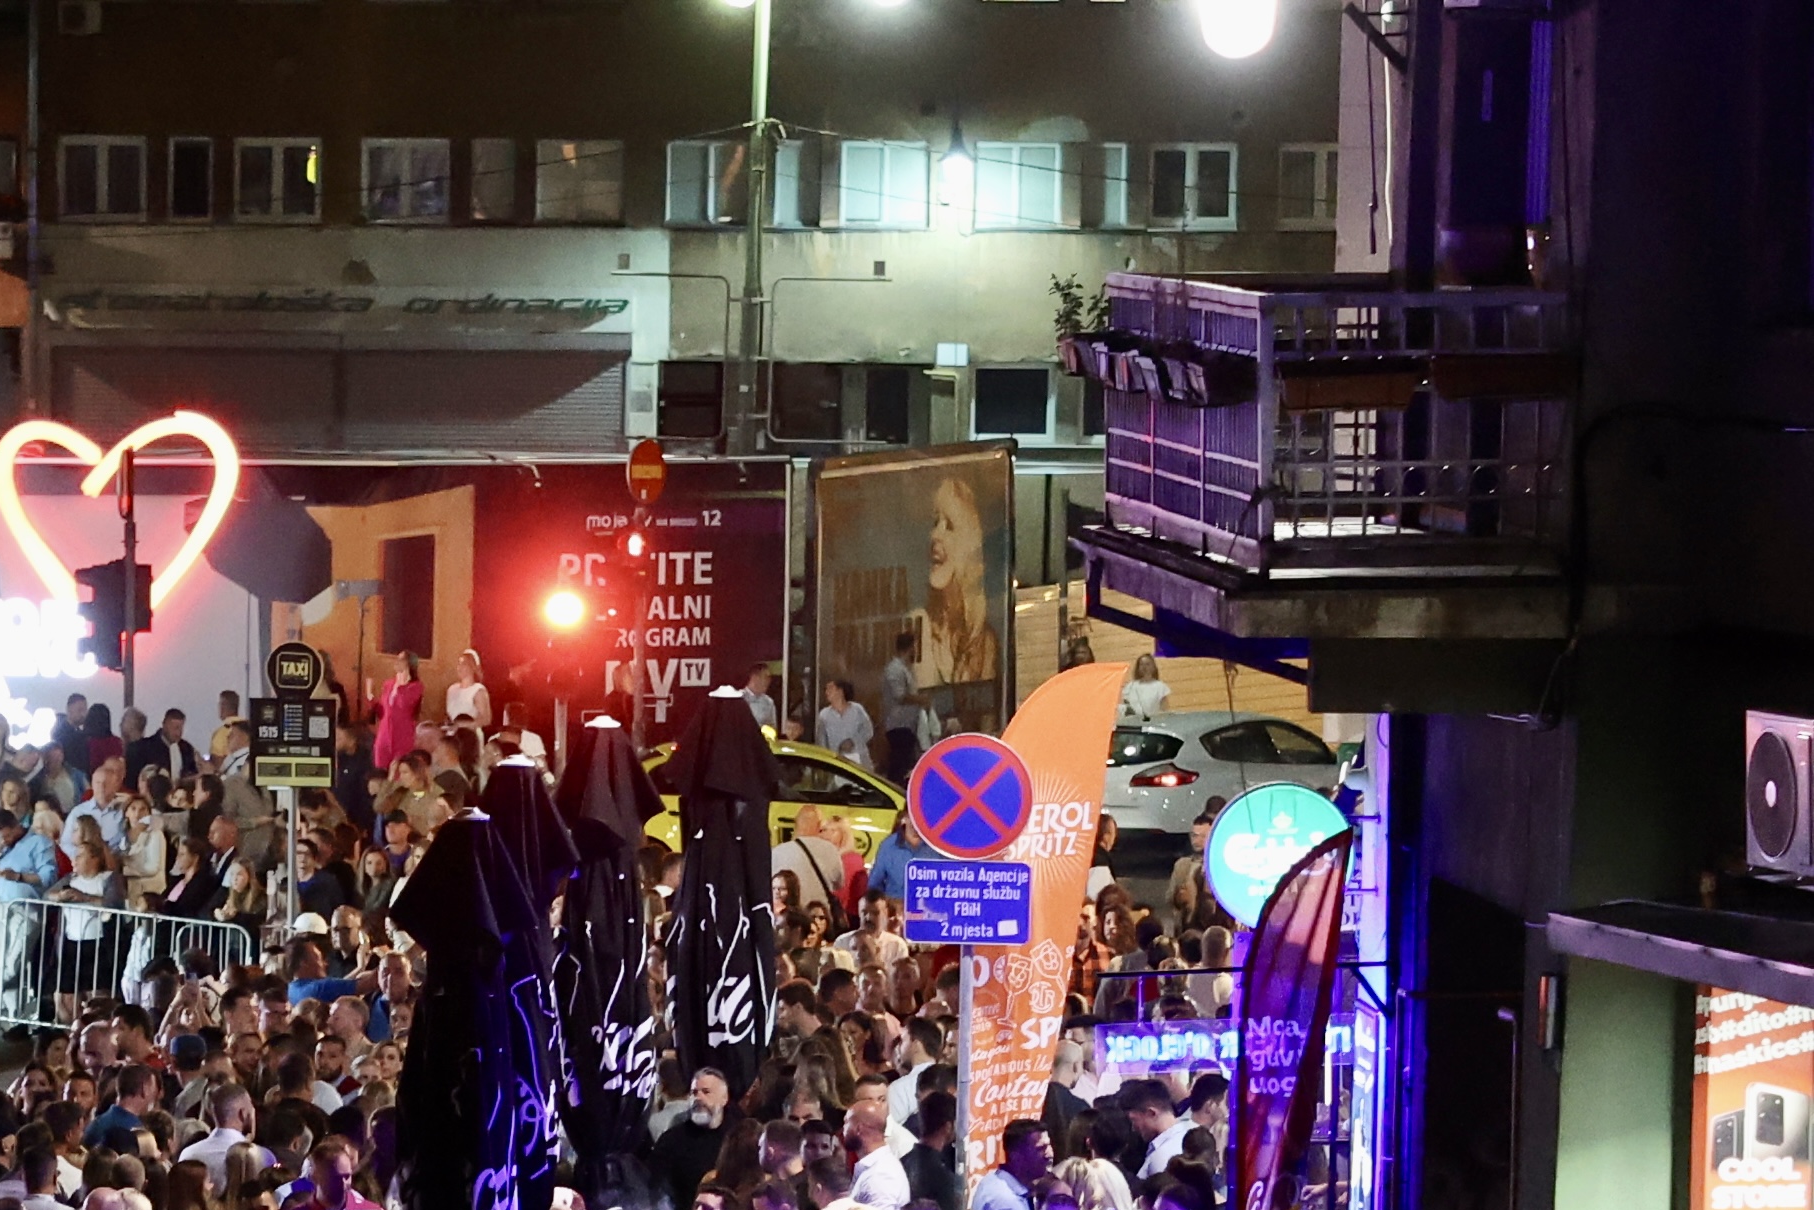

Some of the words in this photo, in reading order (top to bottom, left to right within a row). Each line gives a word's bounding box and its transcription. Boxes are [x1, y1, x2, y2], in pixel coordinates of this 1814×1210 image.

[702, 510, 722, 527] 12
[909, 866, 938, 881] Osim
[941, 867, 975, 882] vozila
[978, 868, 1029, 886] Agencije
[915, 886, 930, 898] za
[933, 884, 980, 899] državnu
[983, 886, 1021, 900] službu
[954, 901, 981, 916] FBiH
[940, 923, 949, 937] 2
[952, 923, 994, 940] mjesta
